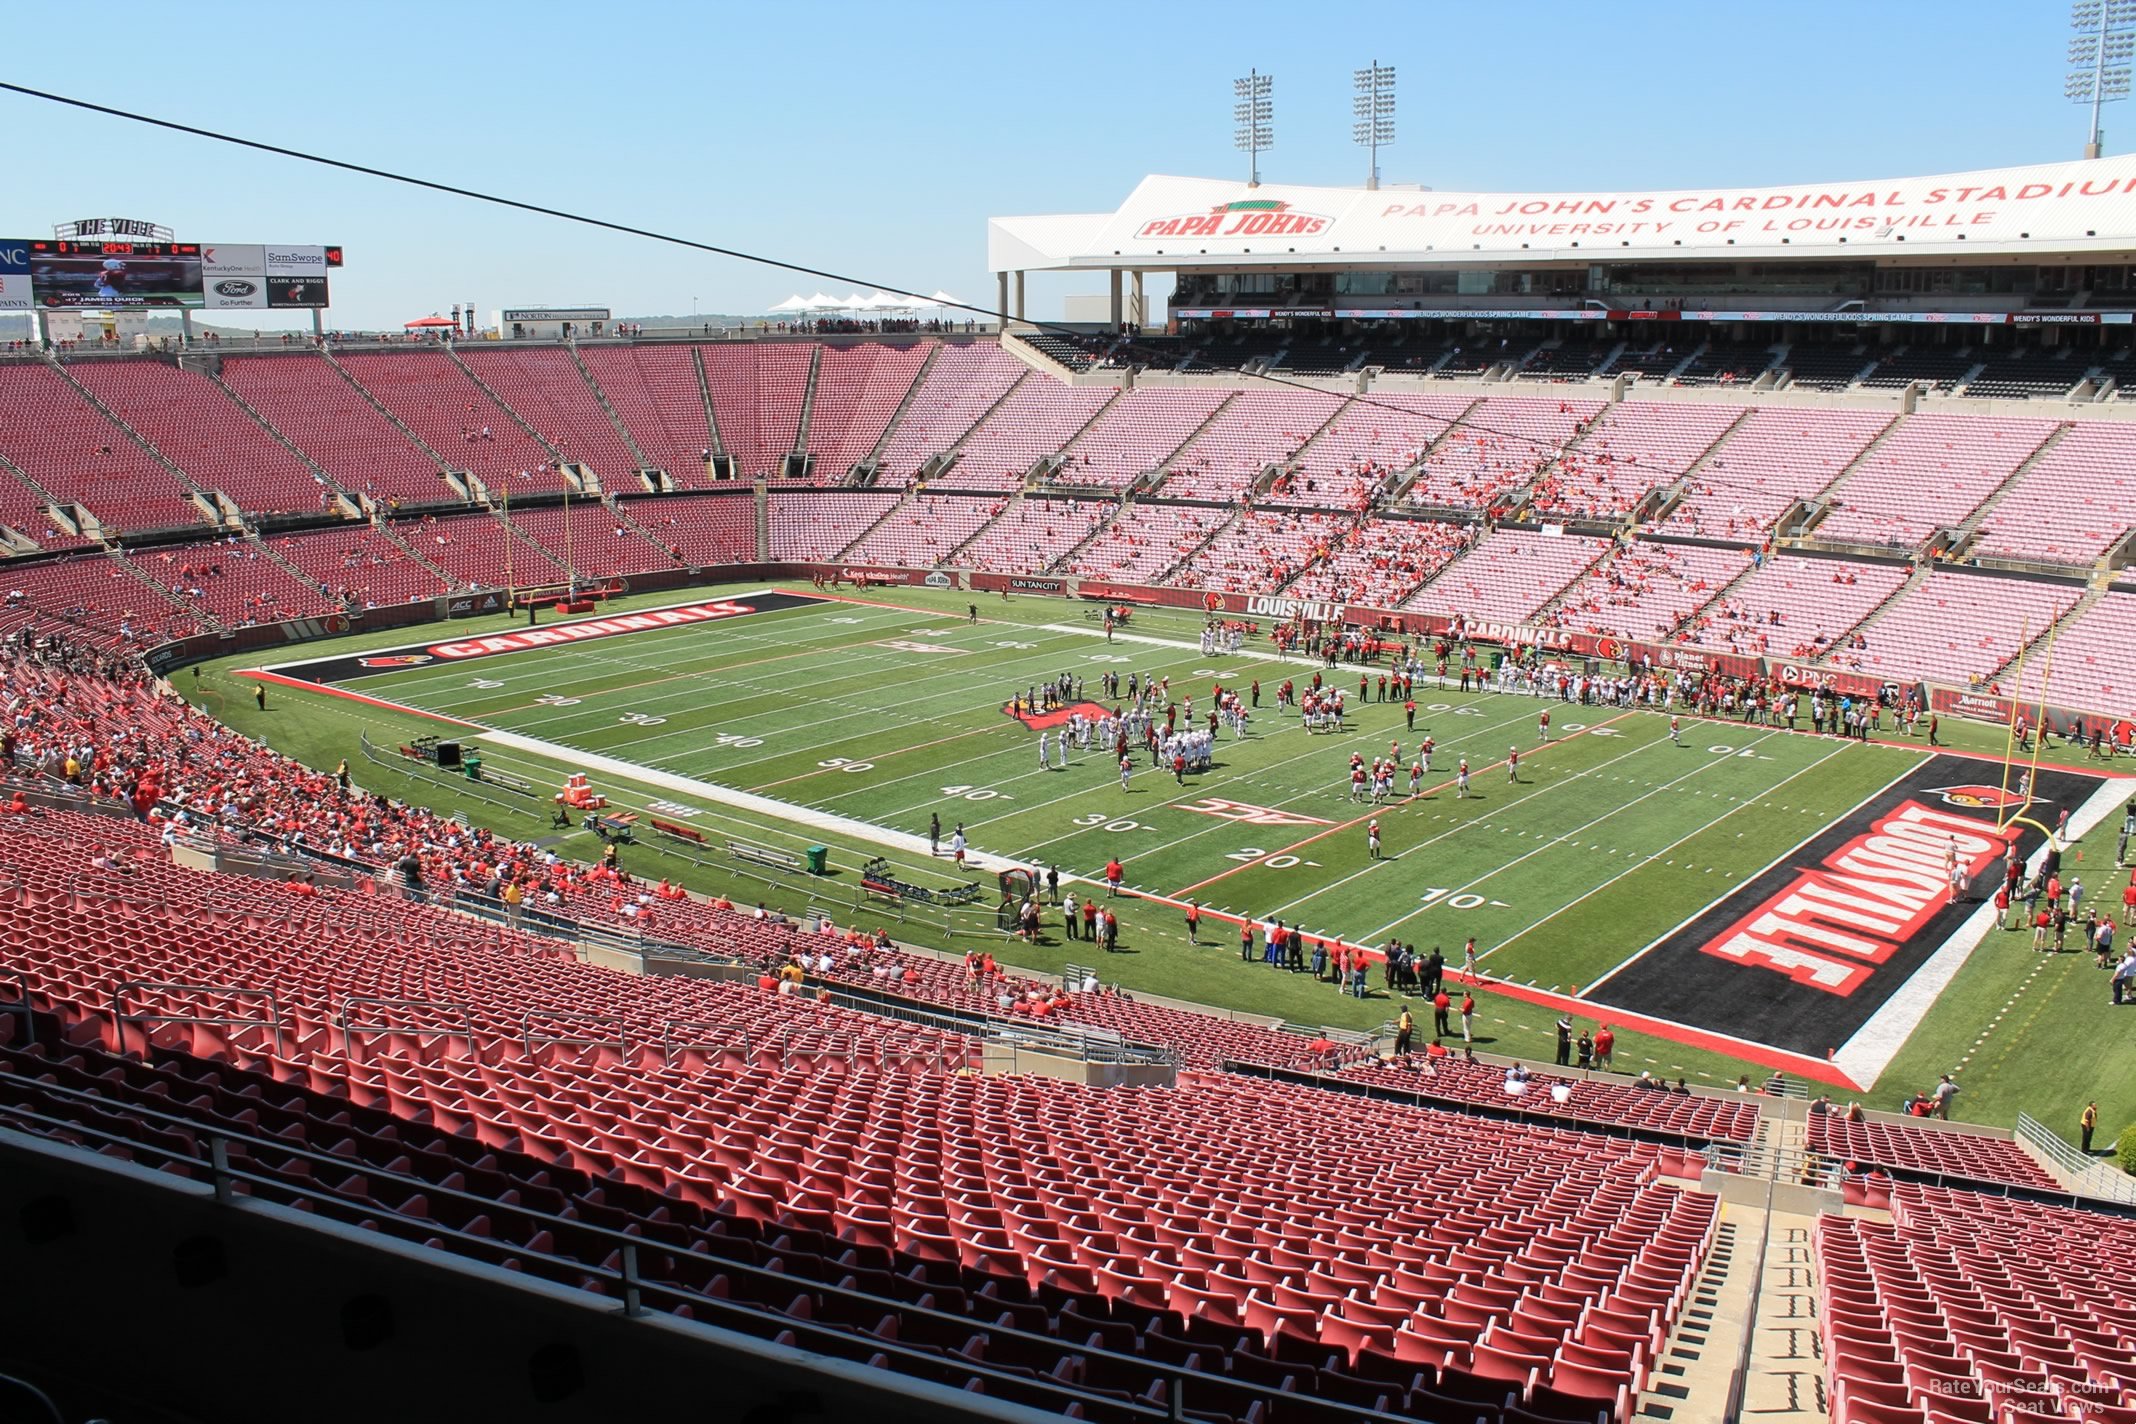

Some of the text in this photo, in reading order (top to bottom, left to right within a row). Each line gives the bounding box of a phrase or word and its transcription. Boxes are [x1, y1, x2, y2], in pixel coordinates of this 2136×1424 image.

[1381, 203, 1479, 218] PAPA
[1496, 198, 1655, 215] JOHN'S
[1669, 191, 1906, 212] CARDINAL
[77, 218, 155, 237] THE VILLE
[1142, 214, 1225, 236] PAPA
[1472, 211, 1996, 236] UNIVERSITY OF LOUISVILLE
[327, 250, 340, 261] 40
[222, 282, 249, 294] Ford
[1804, 312, 1844, 321] WONDERFUL
[1863, 312, 1889, 321] SPRING
[1890, 312, 1912, 321] GAME
[1012, 579, 1026, 588] SUN
[451, 600, 472, 609] ACC
[436, 600, 753, 657] CARDINALS
[1674, 651, 1704, 662] planet
[818, 757, 875, 773] 50
[941, 784, 998, 800] 40
[1072, 813, 1140, 832] 30
[1225, 847, 1300, 868] 20
[1420, 887, 1486, 909] 10
[1717, 806, 2007, 987] LOUISVILLE
